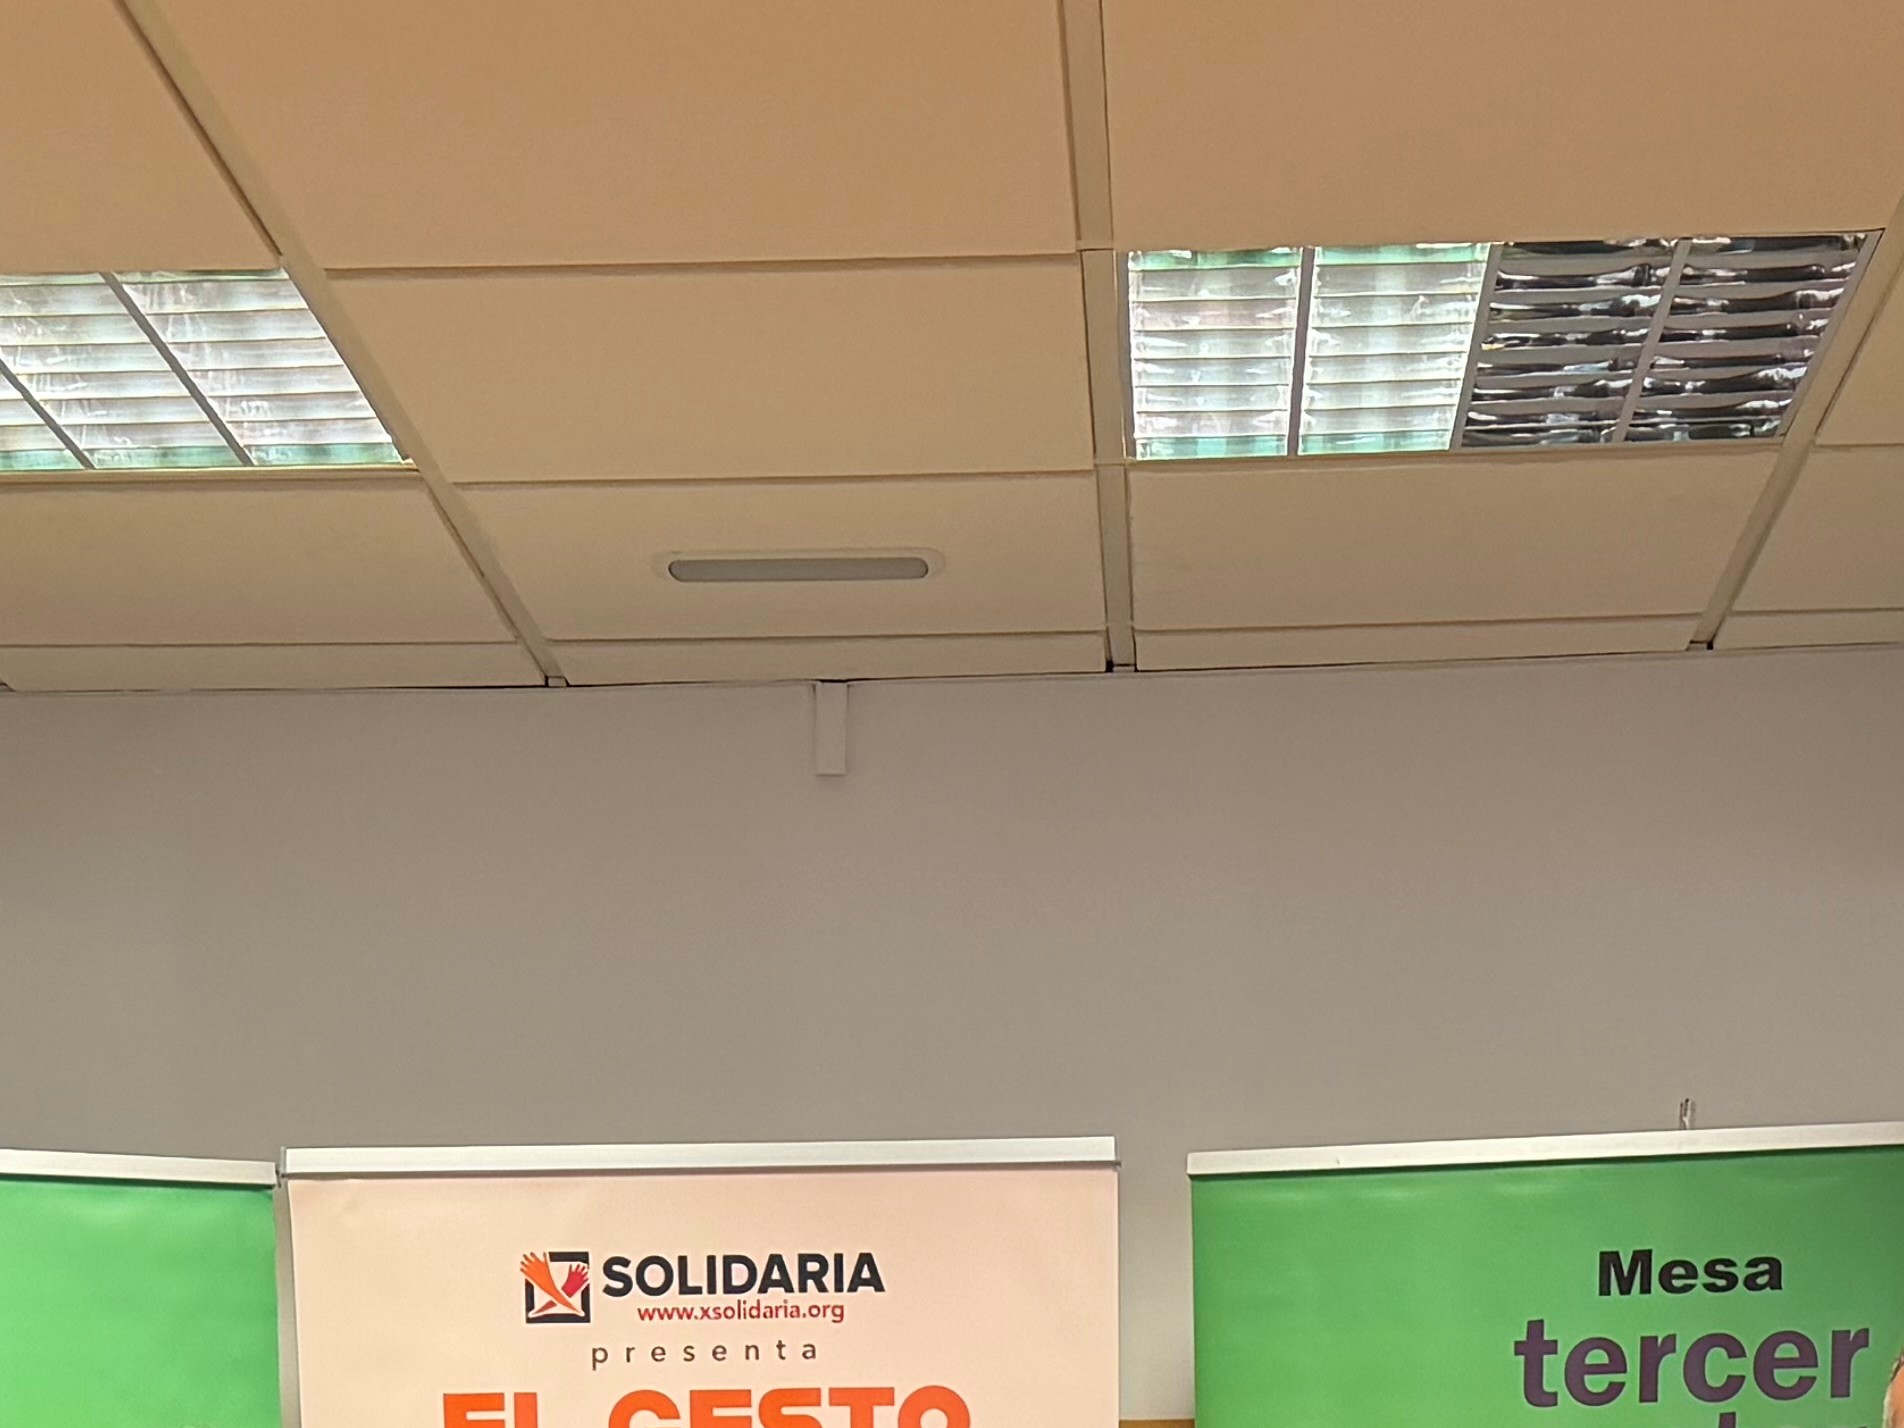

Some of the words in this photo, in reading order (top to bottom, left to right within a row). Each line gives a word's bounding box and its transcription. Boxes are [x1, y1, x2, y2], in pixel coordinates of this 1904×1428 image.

[602, 1252, 885, 1298] SOLIDARIA
[1598, 1248, 1783, 1296] Mesa
[637, 1300, 845, 1324] www.xsolidaria.org
[591, 1339, 818, 1371] presenta
[1513, 1319, 1871, 1408] tercer
